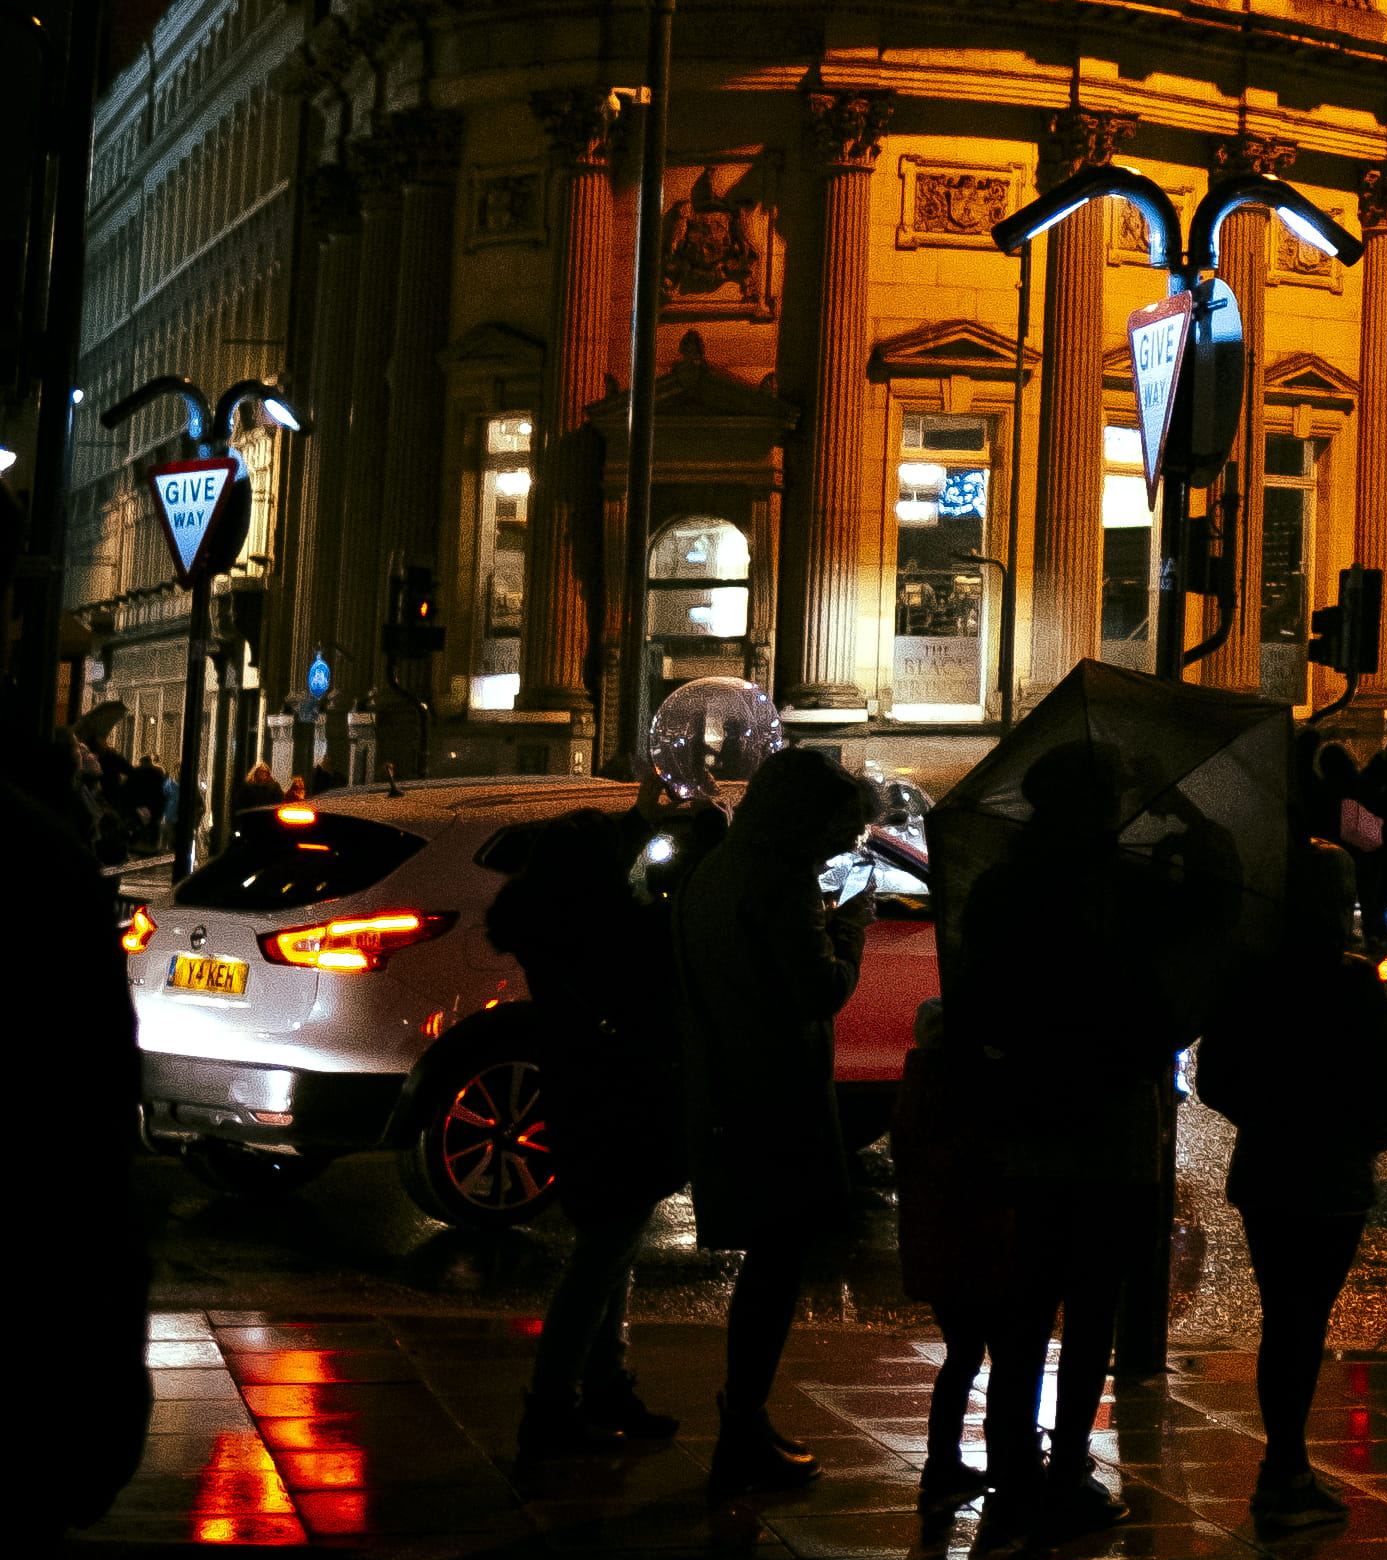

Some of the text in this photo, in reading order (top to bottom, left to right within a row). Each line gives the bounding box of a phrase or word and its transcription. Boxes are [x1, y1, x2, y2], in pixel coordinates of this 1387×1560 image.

[1140, 323, 1174, 371] GIVE
[1144, 378, 1167, 408] WAY
[165, 477, 215, 505] GIVE
[173, 509, 205, 529] WAY
